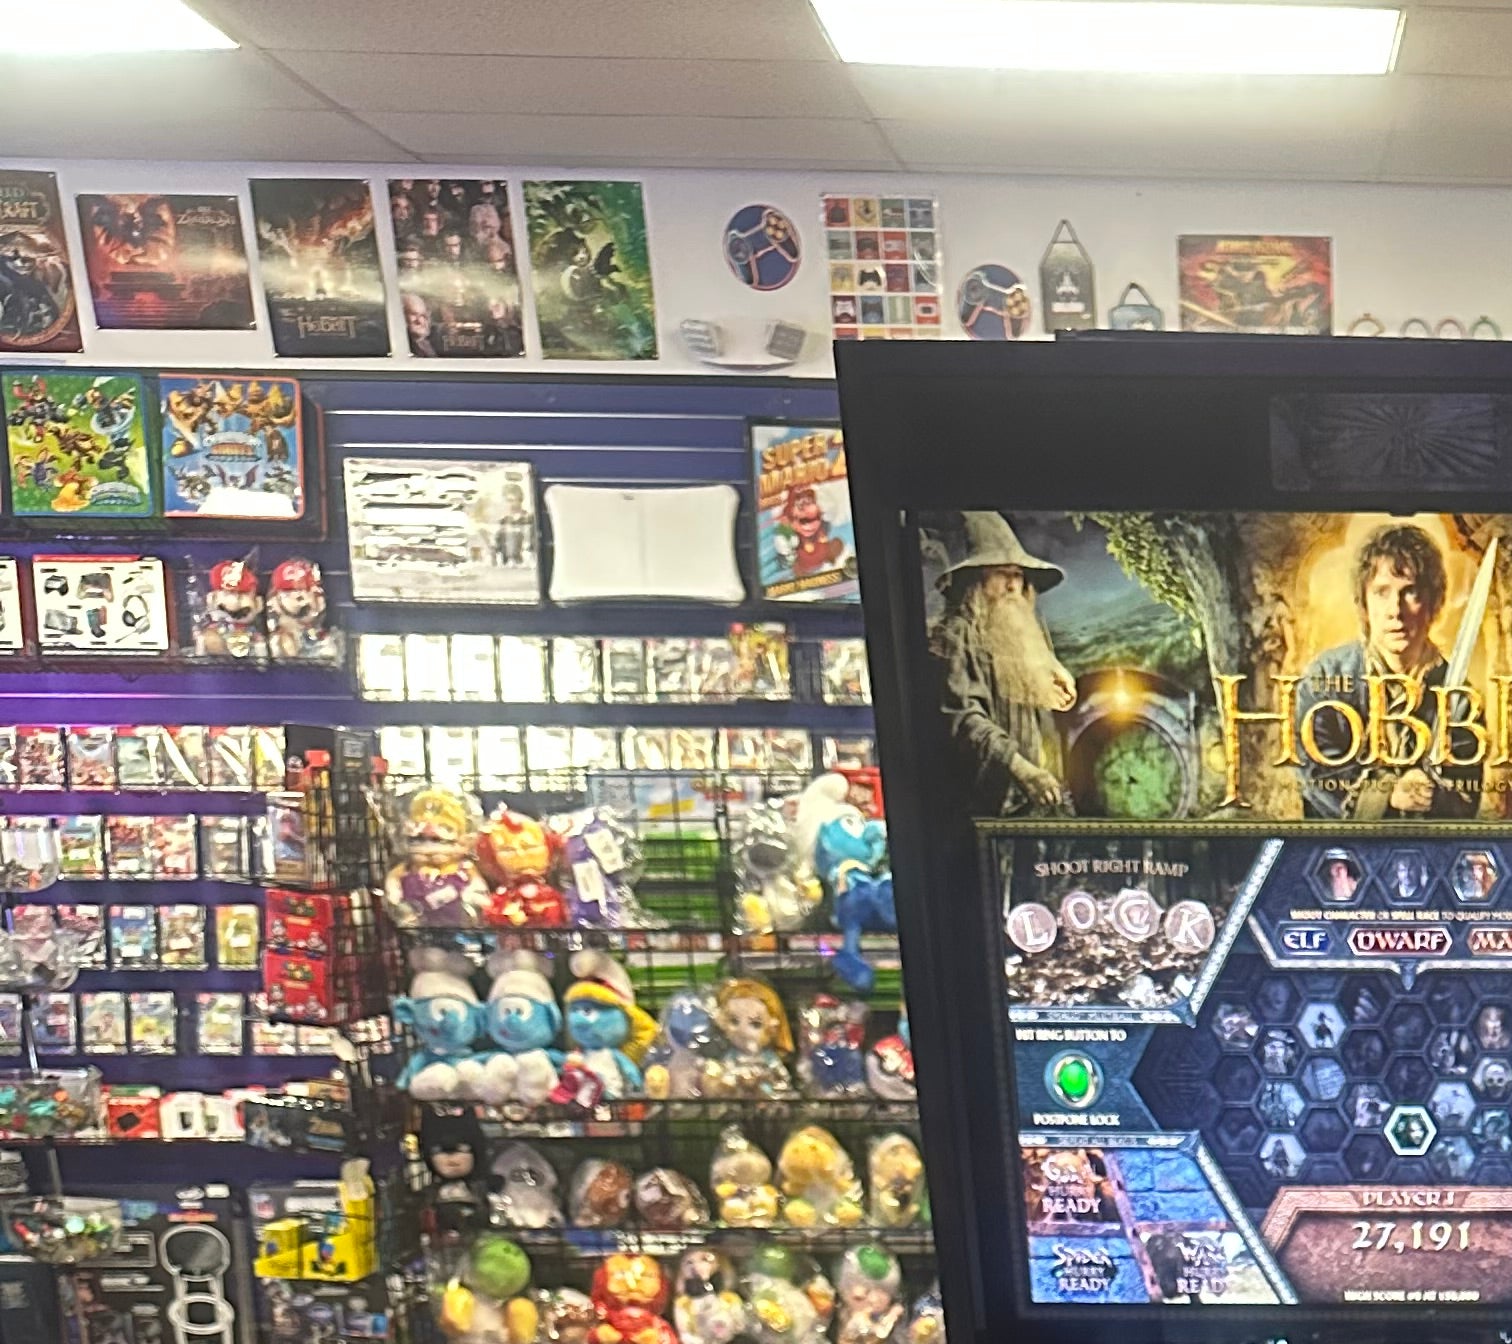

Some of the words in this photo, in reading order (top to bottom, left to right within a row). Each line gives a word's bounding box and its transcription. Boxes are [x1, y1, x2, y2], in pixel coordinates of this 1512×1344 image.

[762, 433, 827, 470] SUPER
[1311, 675, 1354, 694] THE
[1034, 859, 1089, 878] SHOOT
[1092, 859, 1141, 875] RIGHT
[1142, 860, 1190, 878] RAMP
[1283, 932, 1327, 950] ELF
[1355, 931, 1445, 951] DWARF
[1042, 1198, 1102, 1214] READY
[1363, 1191, 1441, 1207] PLAYER
[1352, 1220, 1471, 1254] 27,191
[1059, 1277, 1110, 1292] READY
